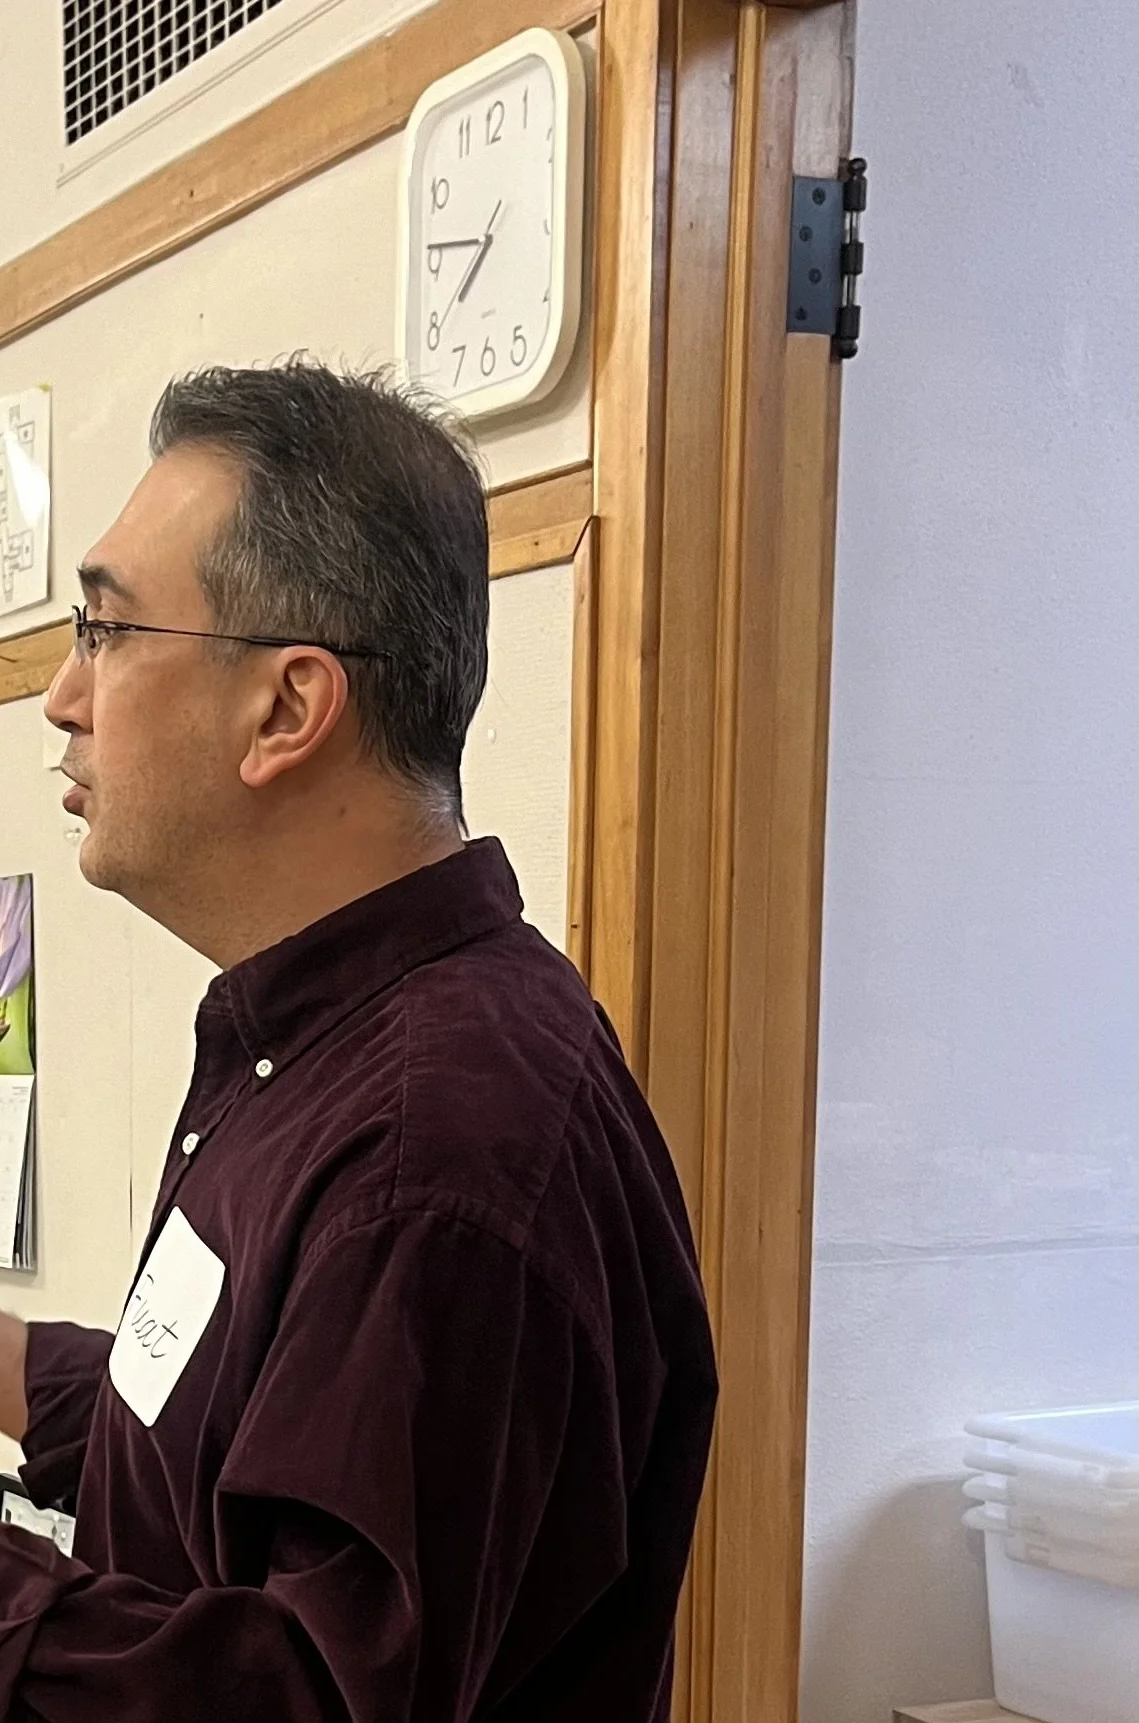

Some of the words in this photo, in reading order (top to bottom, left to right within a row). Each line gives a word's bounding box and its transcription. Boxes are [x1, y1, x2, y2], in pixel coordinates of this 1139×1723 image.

[458, 114, 472, 159] 11
[485, 100, 505, 146] 12
[430, 175, 450, 215] 10
[427, 244, 443, 282] 9
[427, 310, 441, 352] 8
[510, 324, 527, 367] 5
[451, 344, 467, 388] 7
[480, 335, 496, 377] 6
